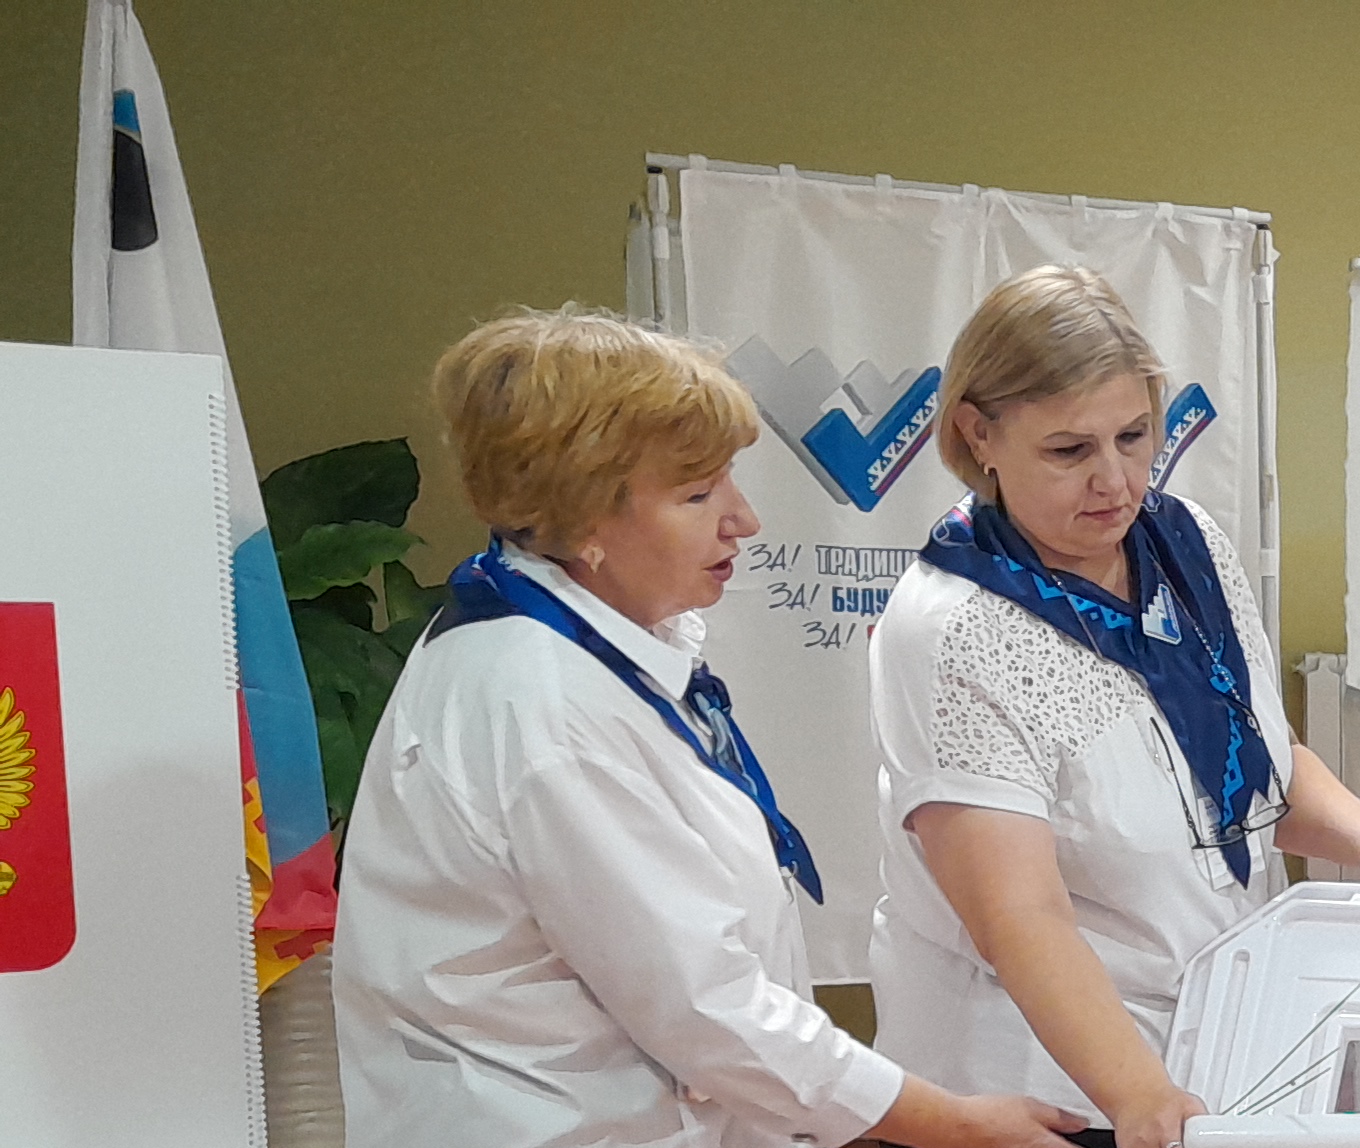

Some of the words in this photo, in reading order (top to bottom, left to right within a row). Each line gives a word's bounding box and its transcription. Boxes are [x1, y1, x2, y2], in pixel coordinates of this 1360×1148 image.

[747, 543, 802, 573] ЗА!
[815, 545, 922, 583] ТРАДИЦ
[767, 582, 821, 612] ЗА!
[832, 586, 894, 617] БУДУ
[802, 621, 857, 649] ЗА!
